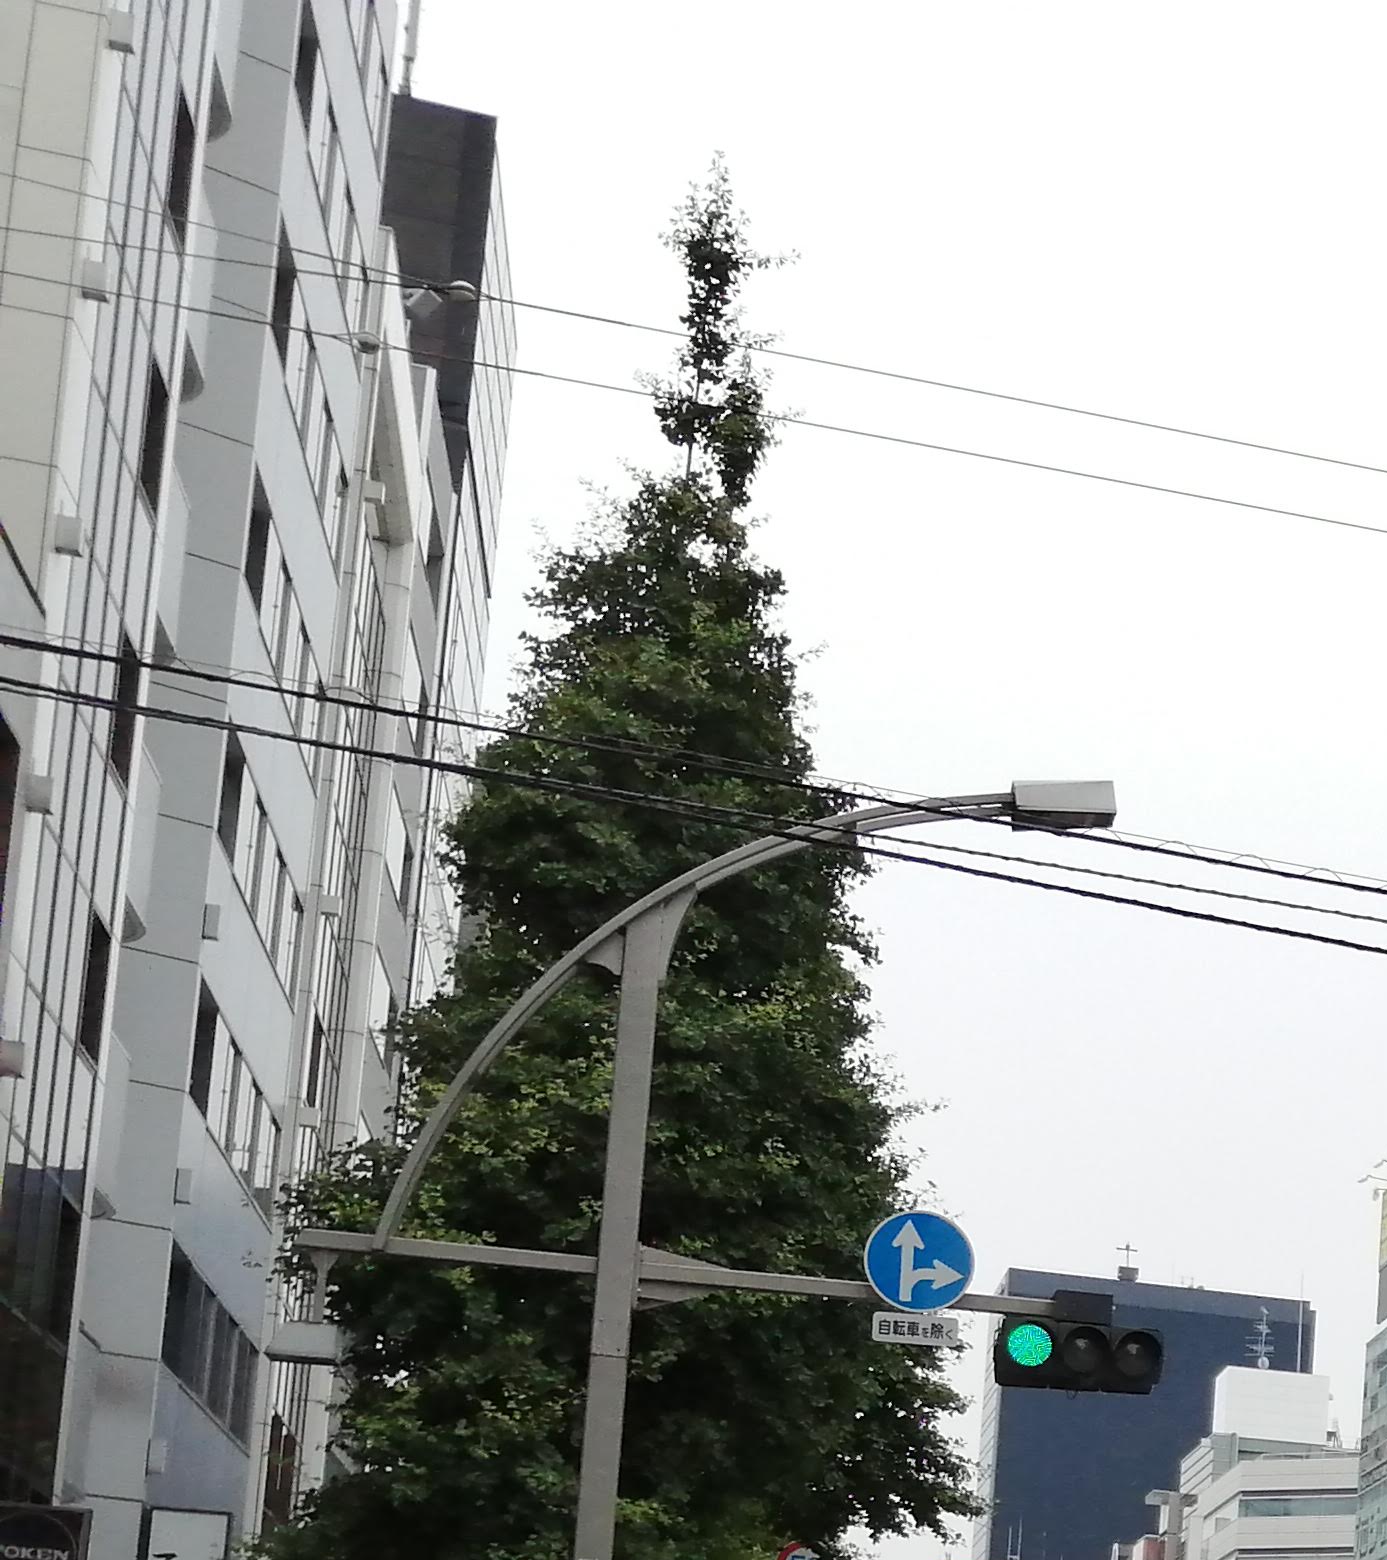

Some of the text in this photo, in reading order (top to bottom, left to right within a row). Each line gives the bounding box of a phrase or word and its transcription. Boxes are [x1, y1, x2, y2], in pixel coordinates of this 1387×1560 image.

[878, 1318, 953, 1340] 自転車を除く
